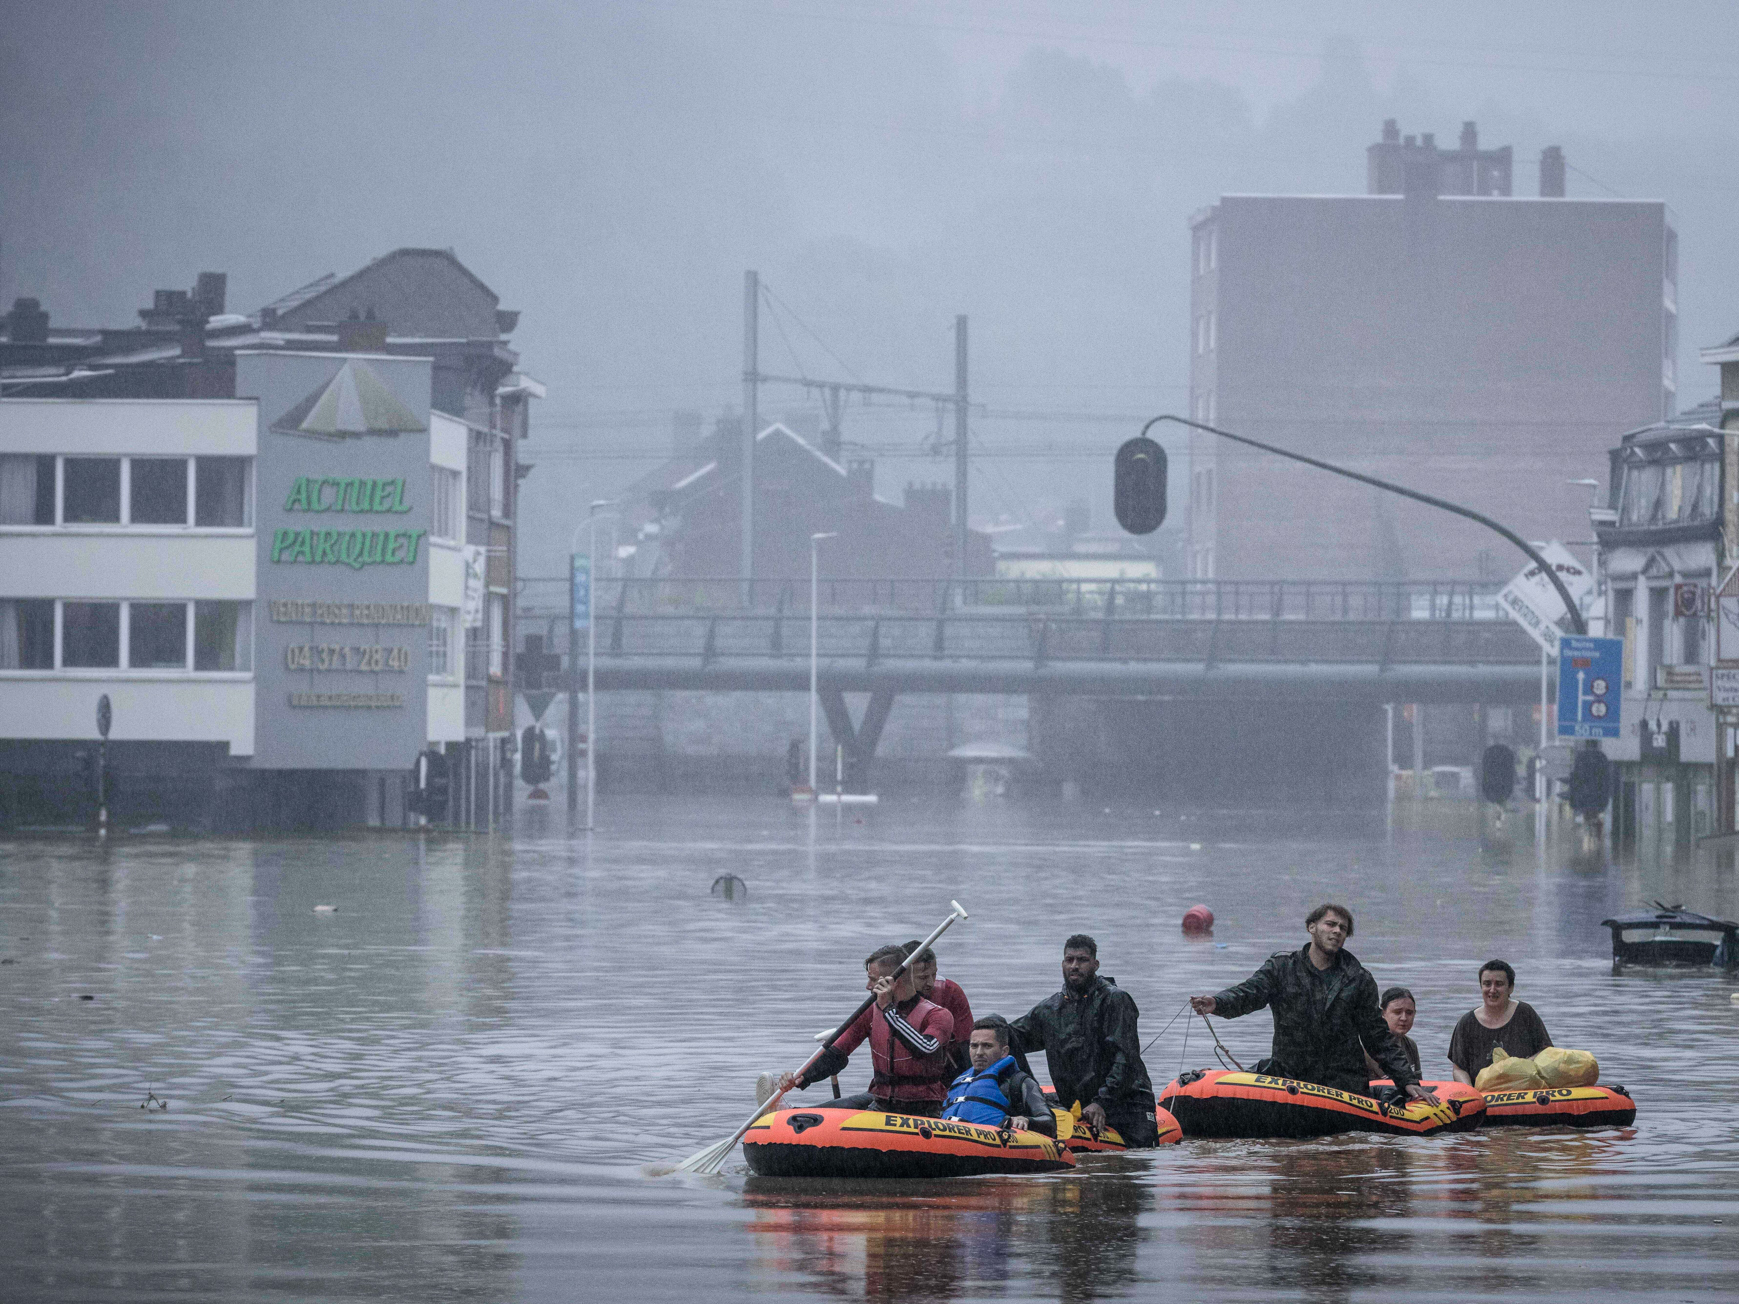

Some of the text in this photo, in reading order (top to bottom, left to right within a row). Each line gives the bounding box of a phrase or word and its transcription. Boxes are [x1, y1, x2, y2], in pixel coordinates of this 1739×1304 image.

[284, 475, 413, 514] ACTUEL
[270, 526, 427, 570] PARQUET
[287, 642, 410, 672] 04 371 28 40
[1254, 1075, 1344, 1099] EXPLORER
[1348, 1094, 1374, 1108] PRO
[1533, 1088, 1573, 1099] PRO
[884, 1114, 973, 1137] EXPLORER
[975, 1128, 997, 1142] PRO
